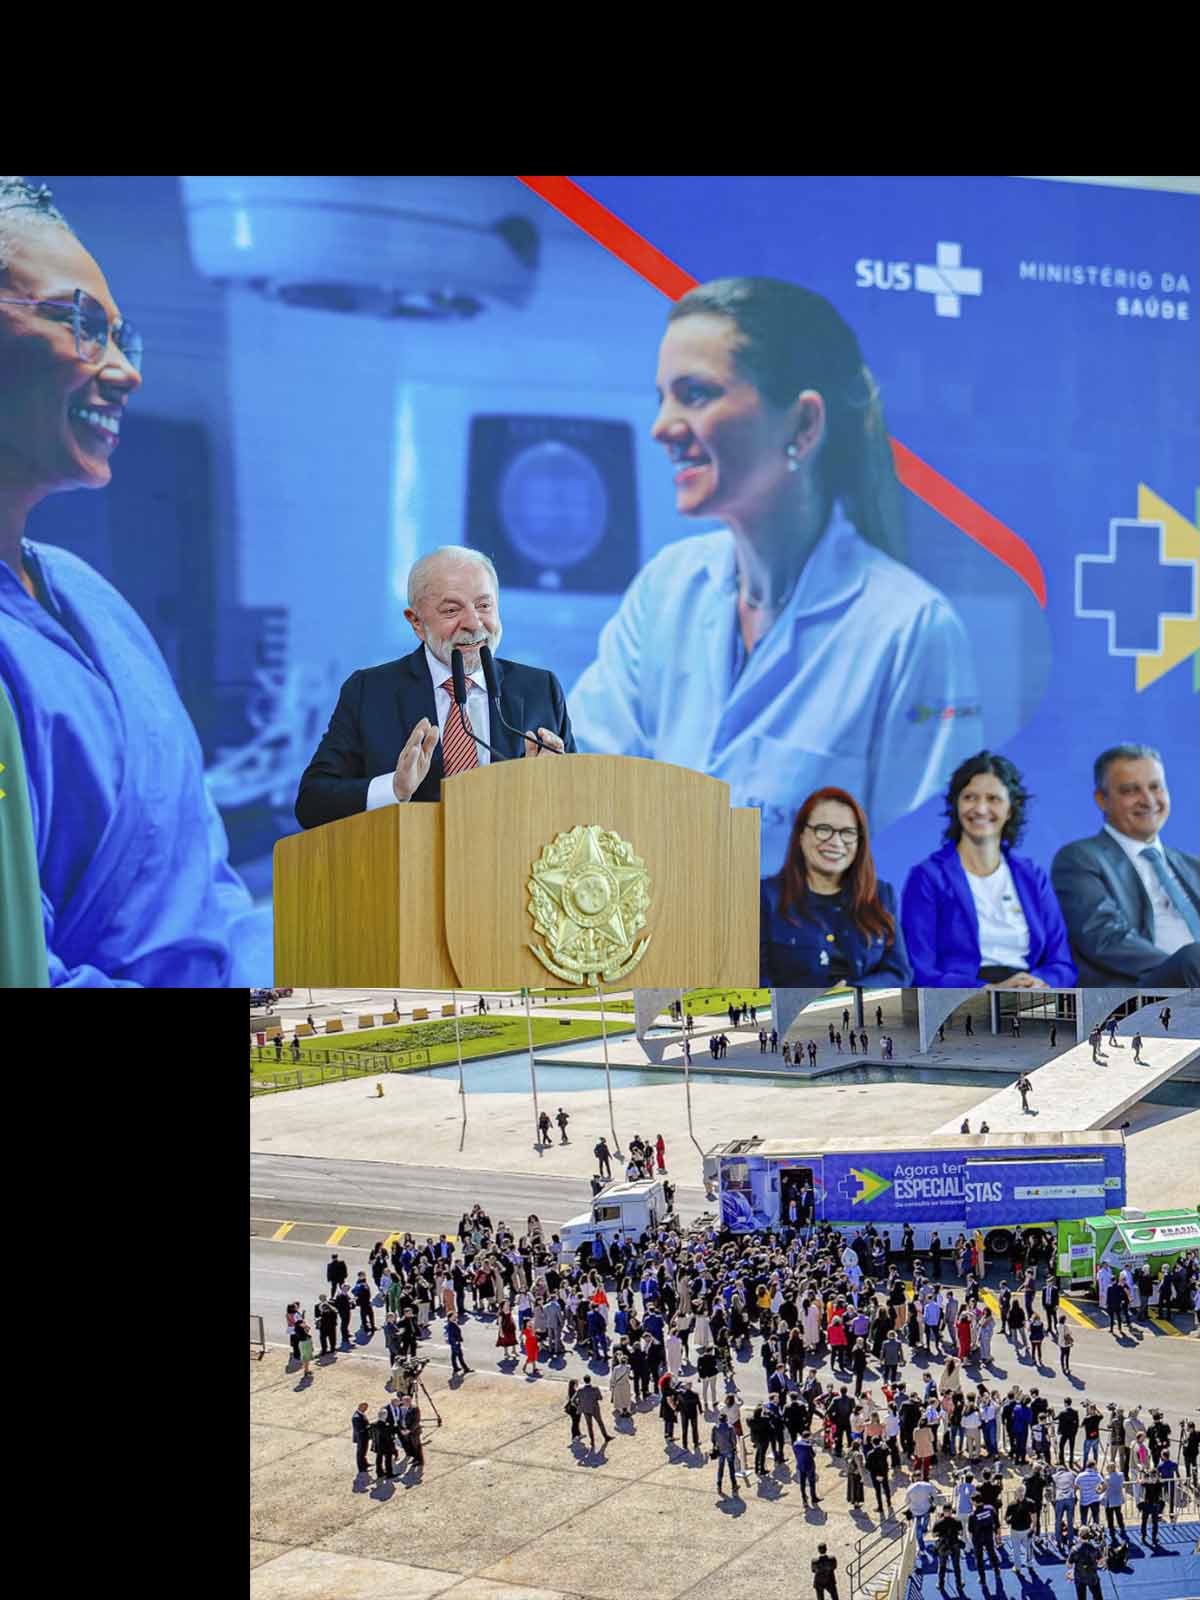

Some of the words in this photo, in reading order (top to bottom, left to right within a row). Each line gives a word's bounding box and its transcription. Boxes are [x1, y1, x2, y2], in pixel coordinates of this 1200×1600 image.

[855, 257, 911, 291] SUS
[1161, 272, 1190, 293] DA
[894, 1164, 939, 1179] Agora
